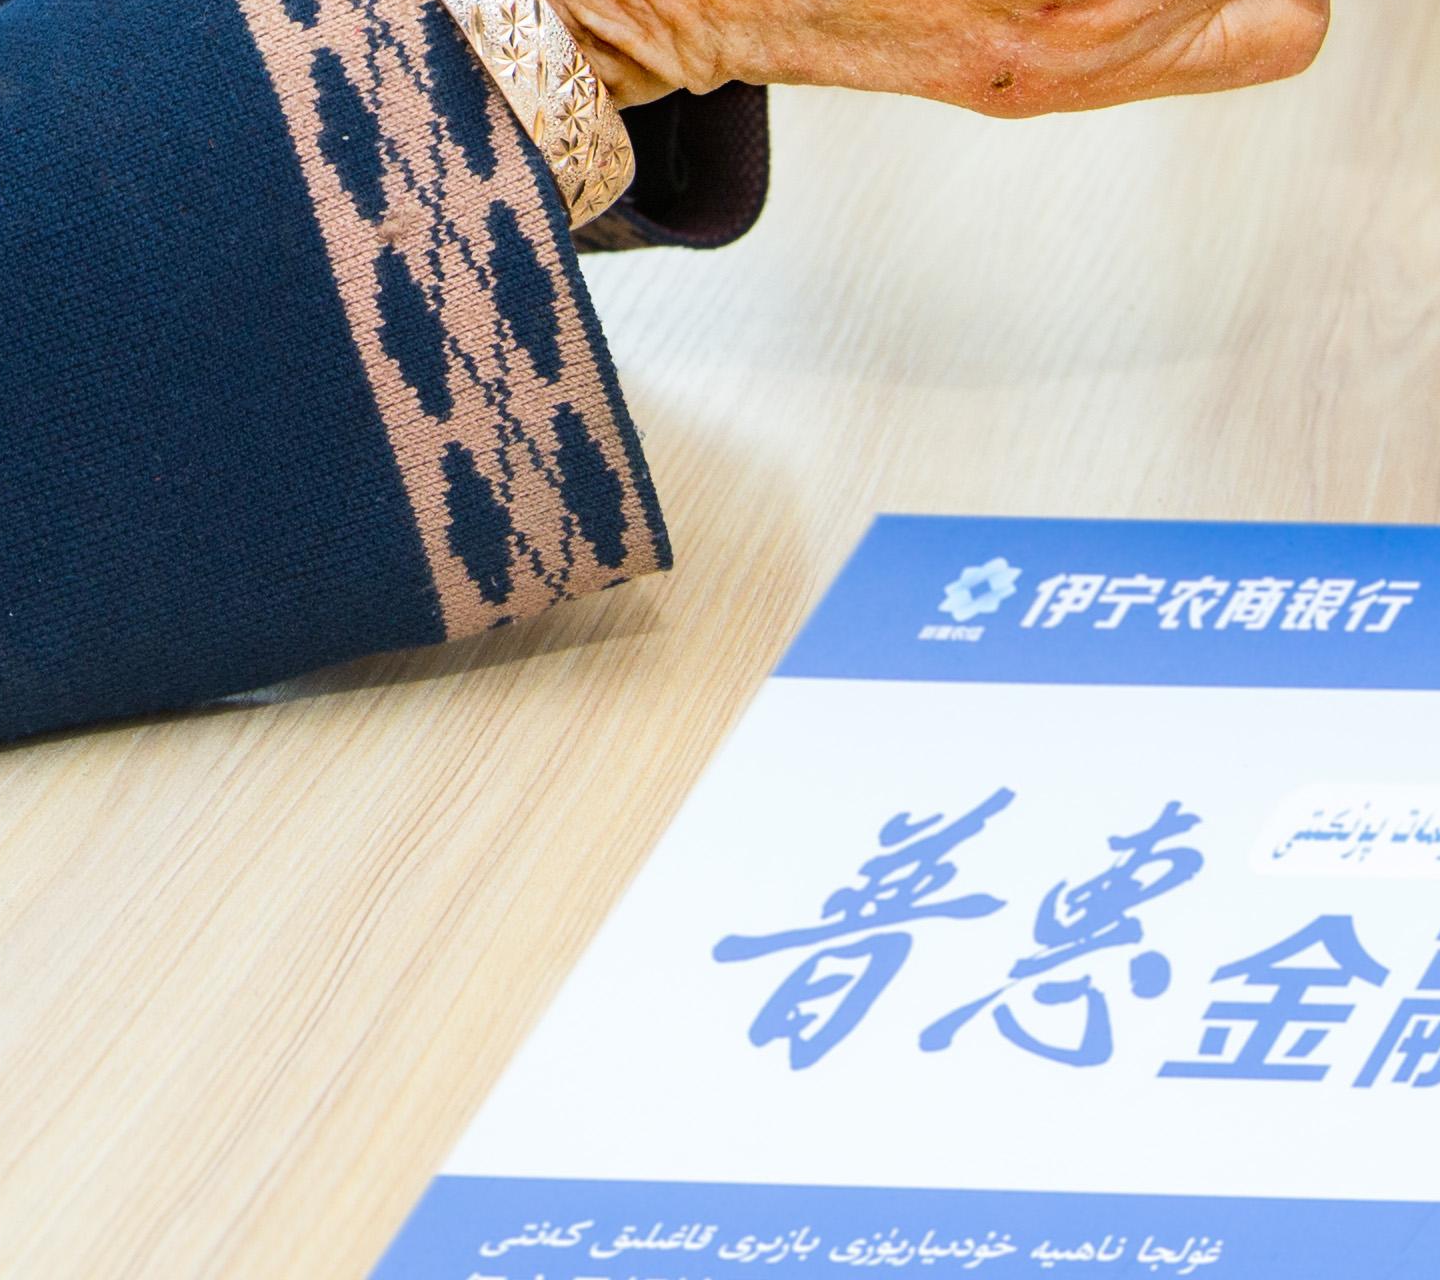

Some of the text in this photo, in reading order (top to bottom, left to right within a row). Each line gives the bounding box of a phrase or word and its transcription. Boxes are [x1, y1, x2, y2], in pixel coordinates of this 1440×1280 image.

[1020, 572, 1421, 633] 伊宁农商银行
